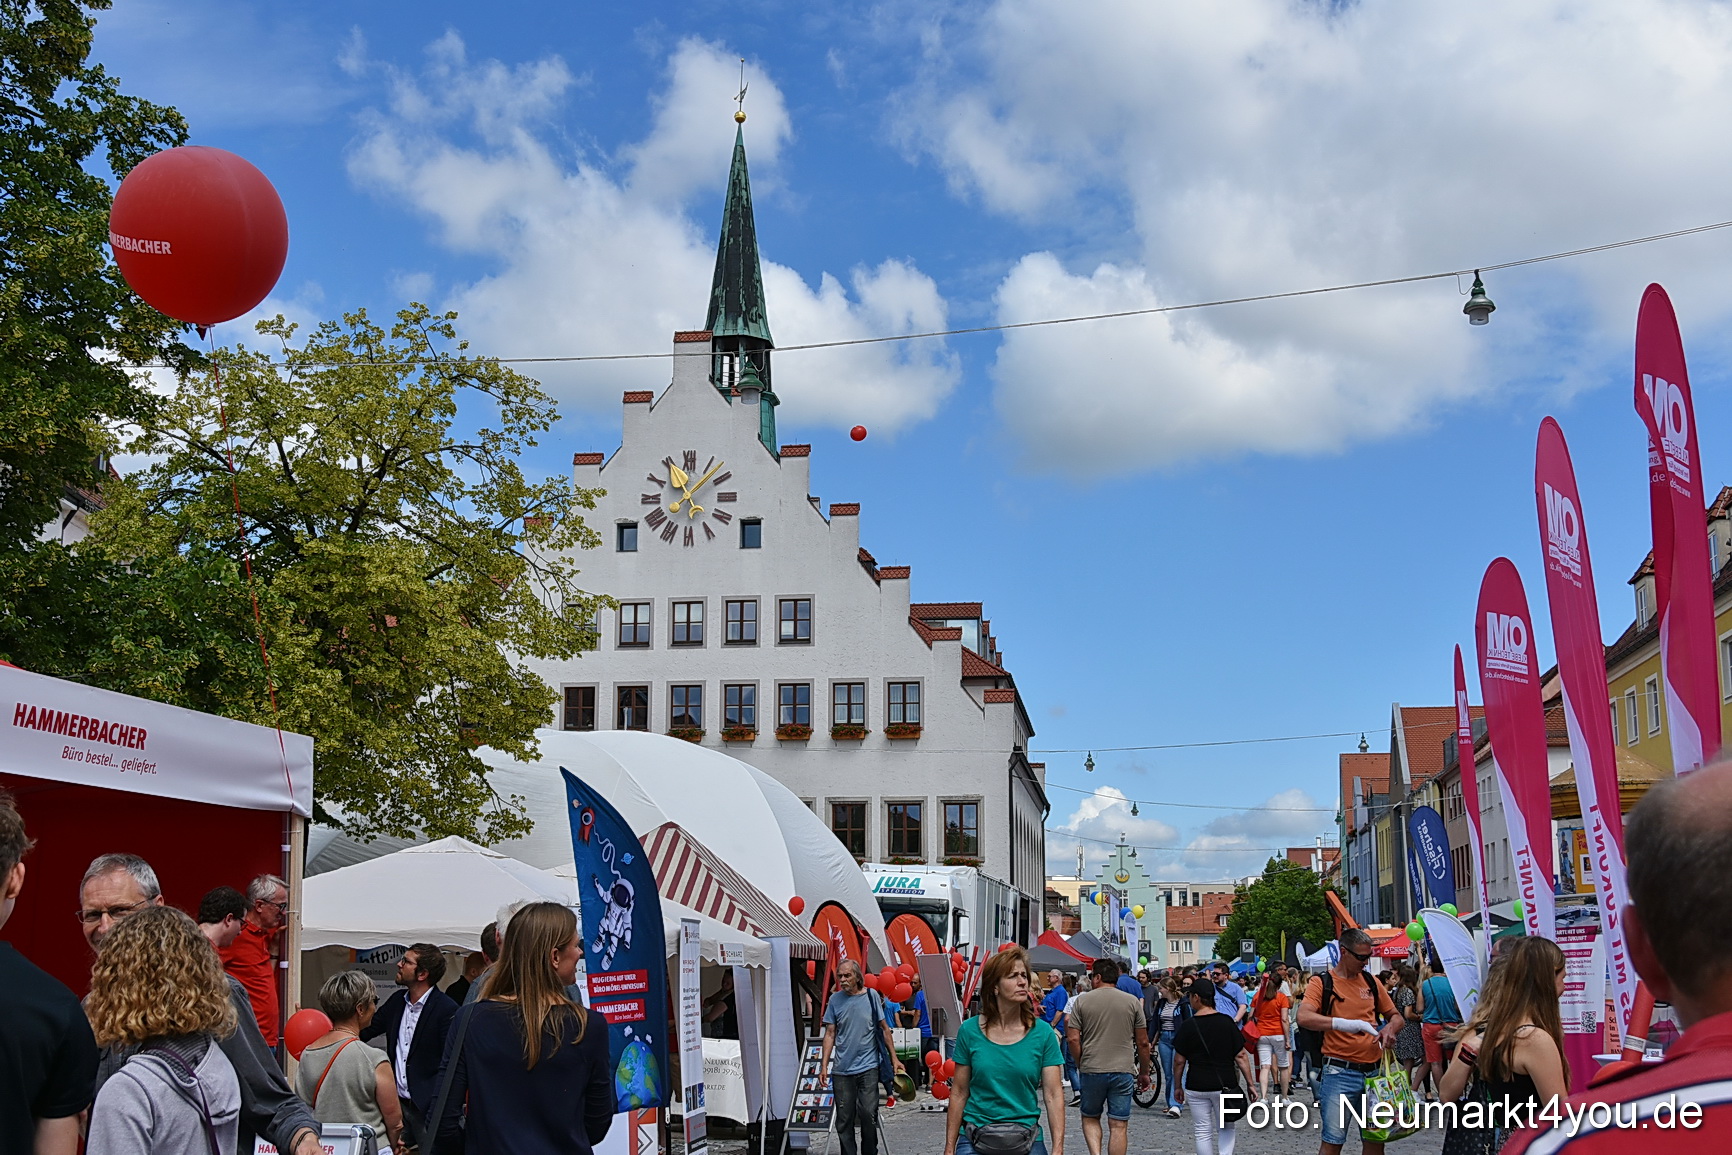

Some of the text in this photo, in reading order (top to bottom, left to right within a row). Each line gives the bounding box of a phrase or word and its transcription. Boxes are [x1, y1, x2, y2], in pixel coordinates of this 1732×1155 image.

[13, 702, 147, 750] HAMMERBACHER
[62, 746, 157, 775] Büro bestel... geliefert.
[872, 876, 922, 893] JURA
